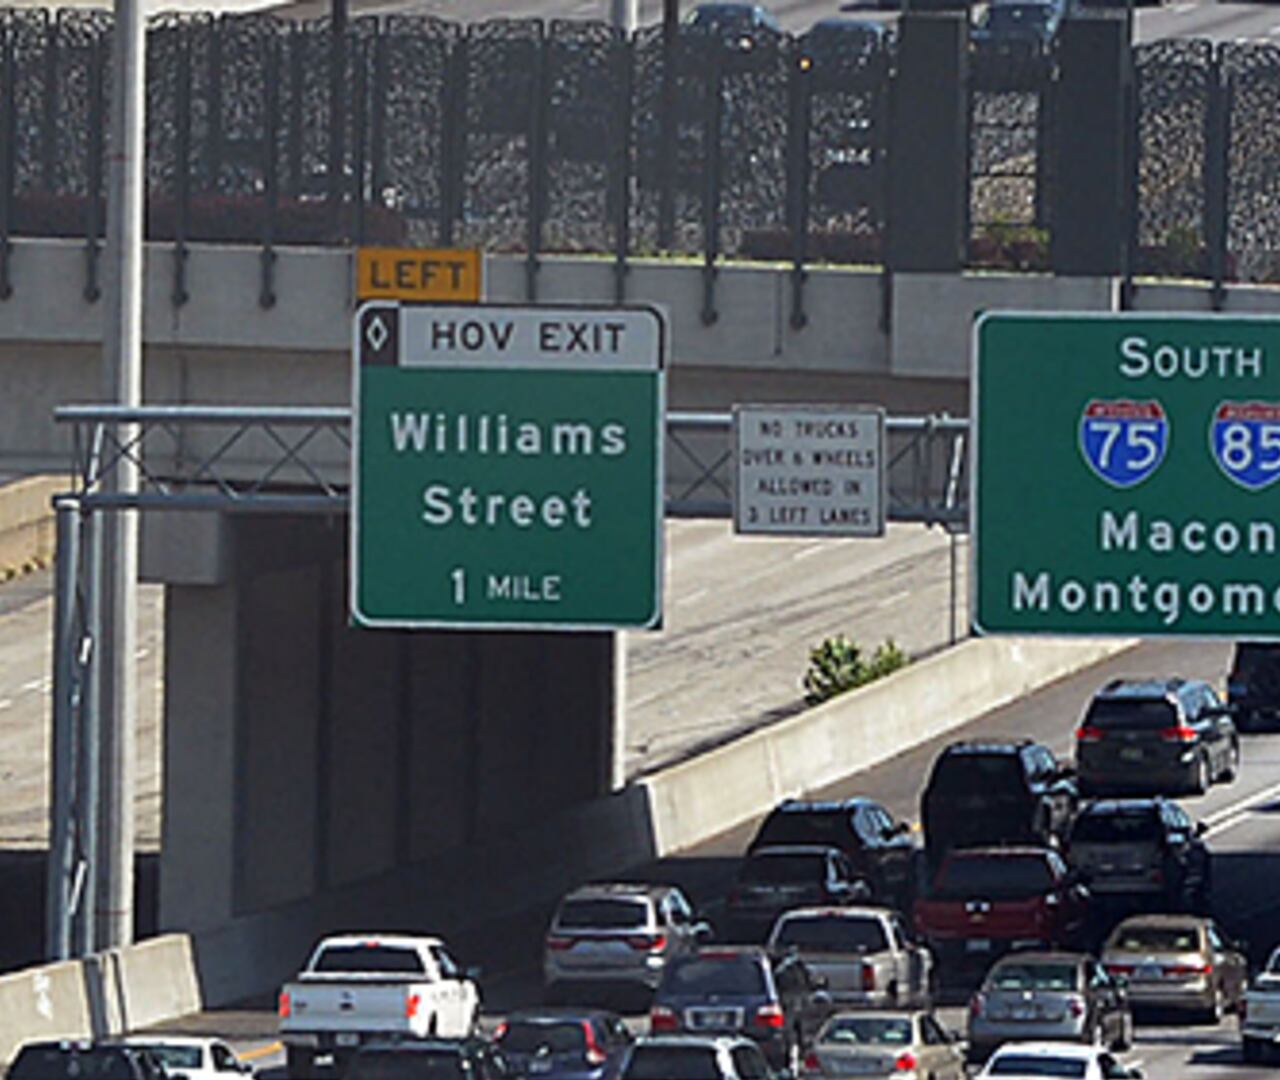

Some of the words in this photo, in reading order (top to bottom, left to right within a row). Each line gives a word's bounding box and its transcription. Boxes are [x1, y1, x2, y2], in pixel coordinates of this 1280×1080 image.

[371, 261, 466, 289] LEFT
[431, 321, 514, 350] HOV
[539, 322, 625, 351] EXIT
[390, 413, 626, 455] Williams
[760, 420, 782, 437] NO
[795, 420, 858, 438] TRUCKS
[743, 450, 783, 466] OVER
[813, 452, 875, 468] WHEELS
[1089, 423, 1158, 469] 75
[758, 479, 833, 496] ALLOWED
[845, 481, 860, 494] IN
[422, 484, 592, 528] Street
[748, 506, 758, 523] 3
[771, 507, 807, 524] LEFT
[821, 508, 870, 526] LANES
[1101, 511, 1276, 552] Macon
[451, 568, 465, 604] 1
[487, 575, 561, 601] MILE
